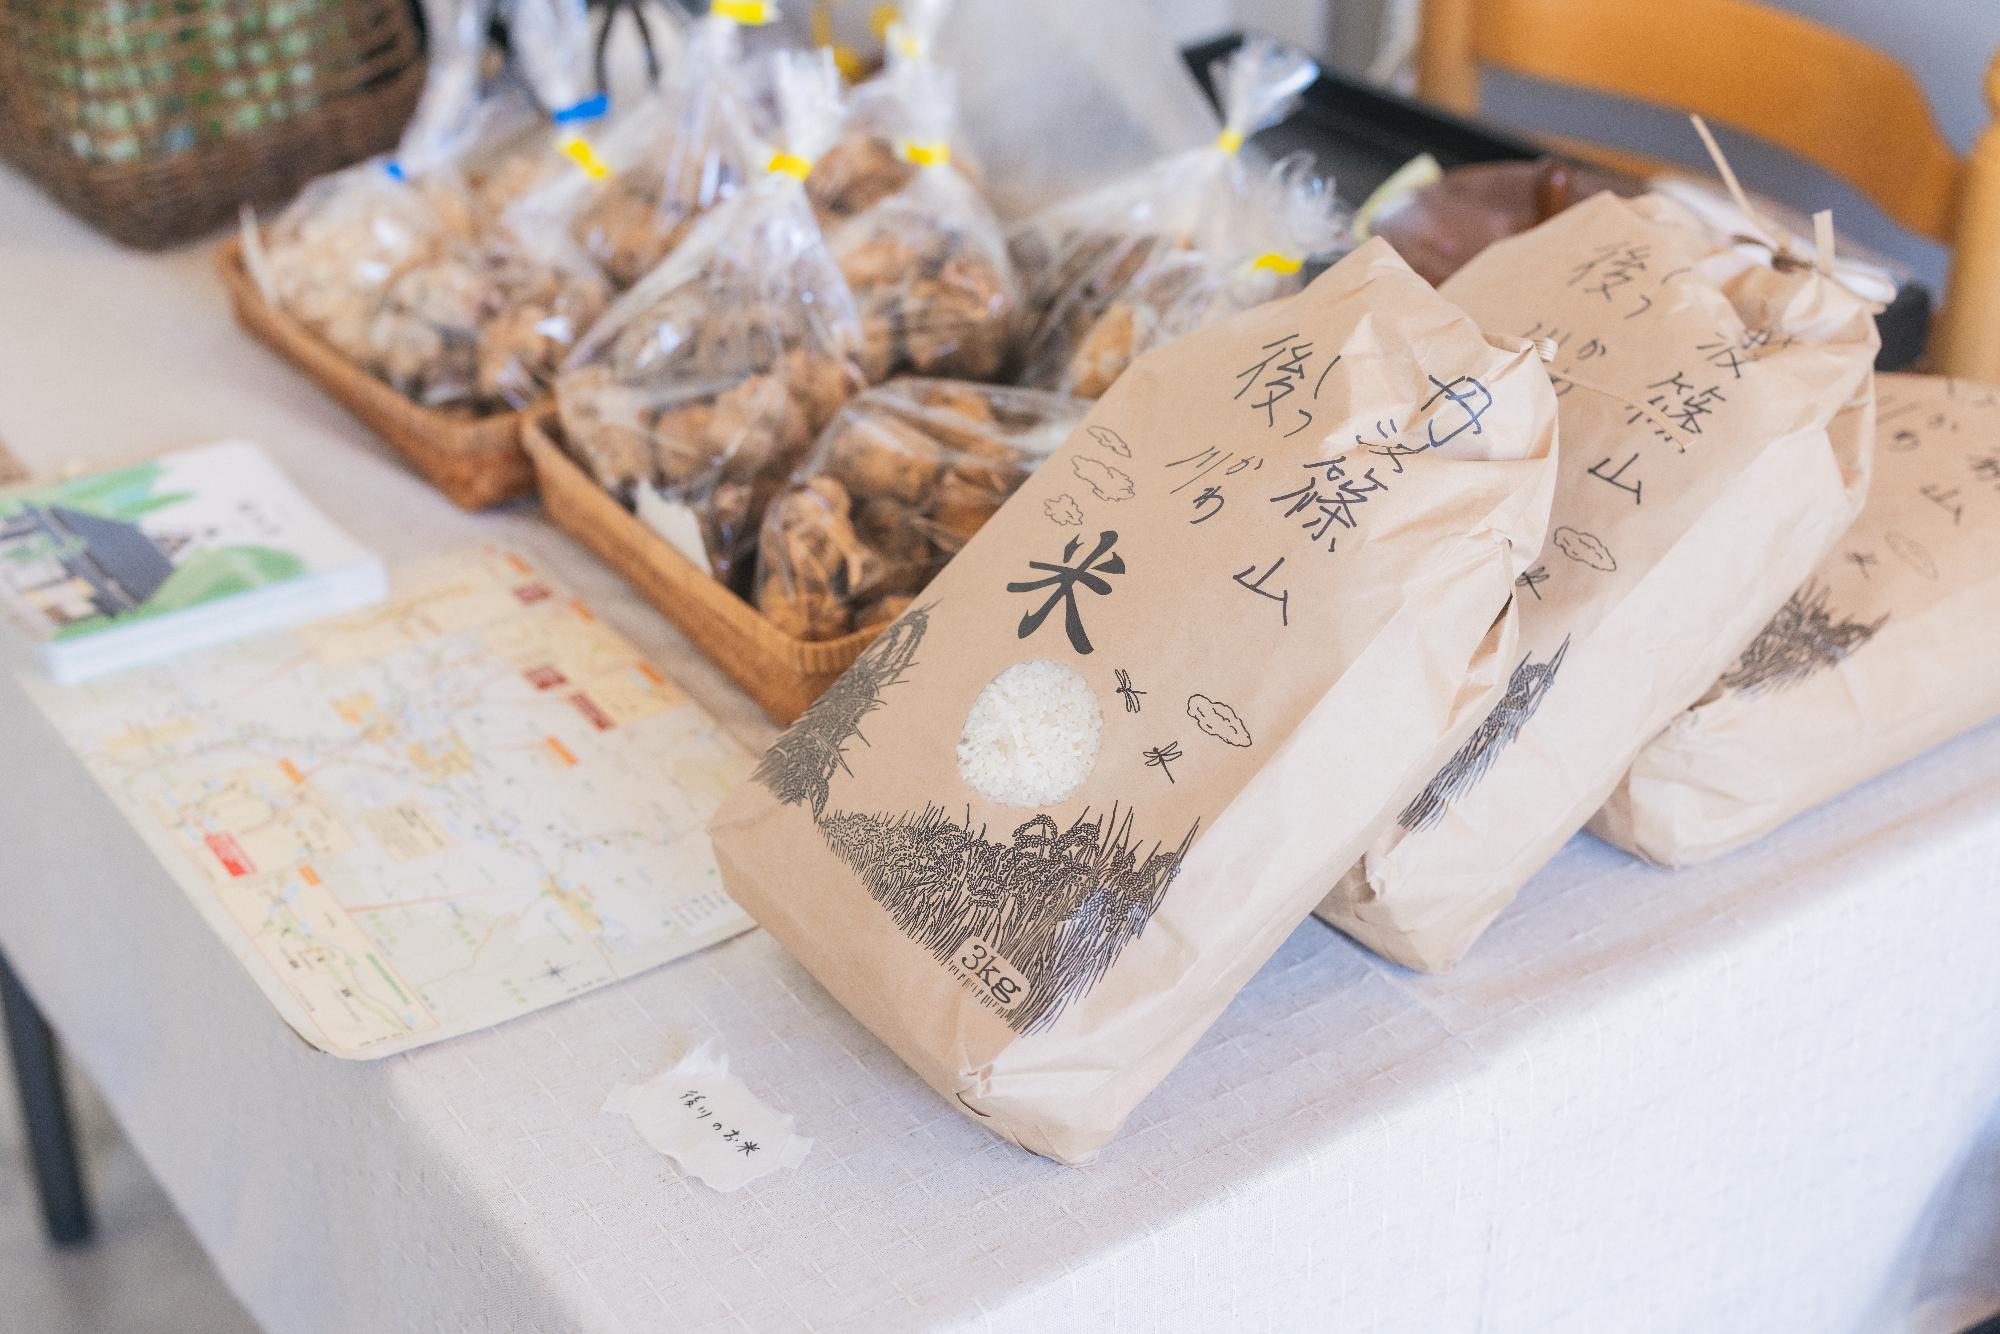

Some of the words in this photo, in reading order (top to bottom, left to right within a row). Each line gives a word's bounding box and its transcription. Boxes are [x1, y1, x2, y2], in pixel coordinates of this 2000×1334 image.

[1006, 530, 1126, 656] 米
[961, 944, 1022, 1005] 3kg
[679, 1090, 761, 1158] 後川のお米
